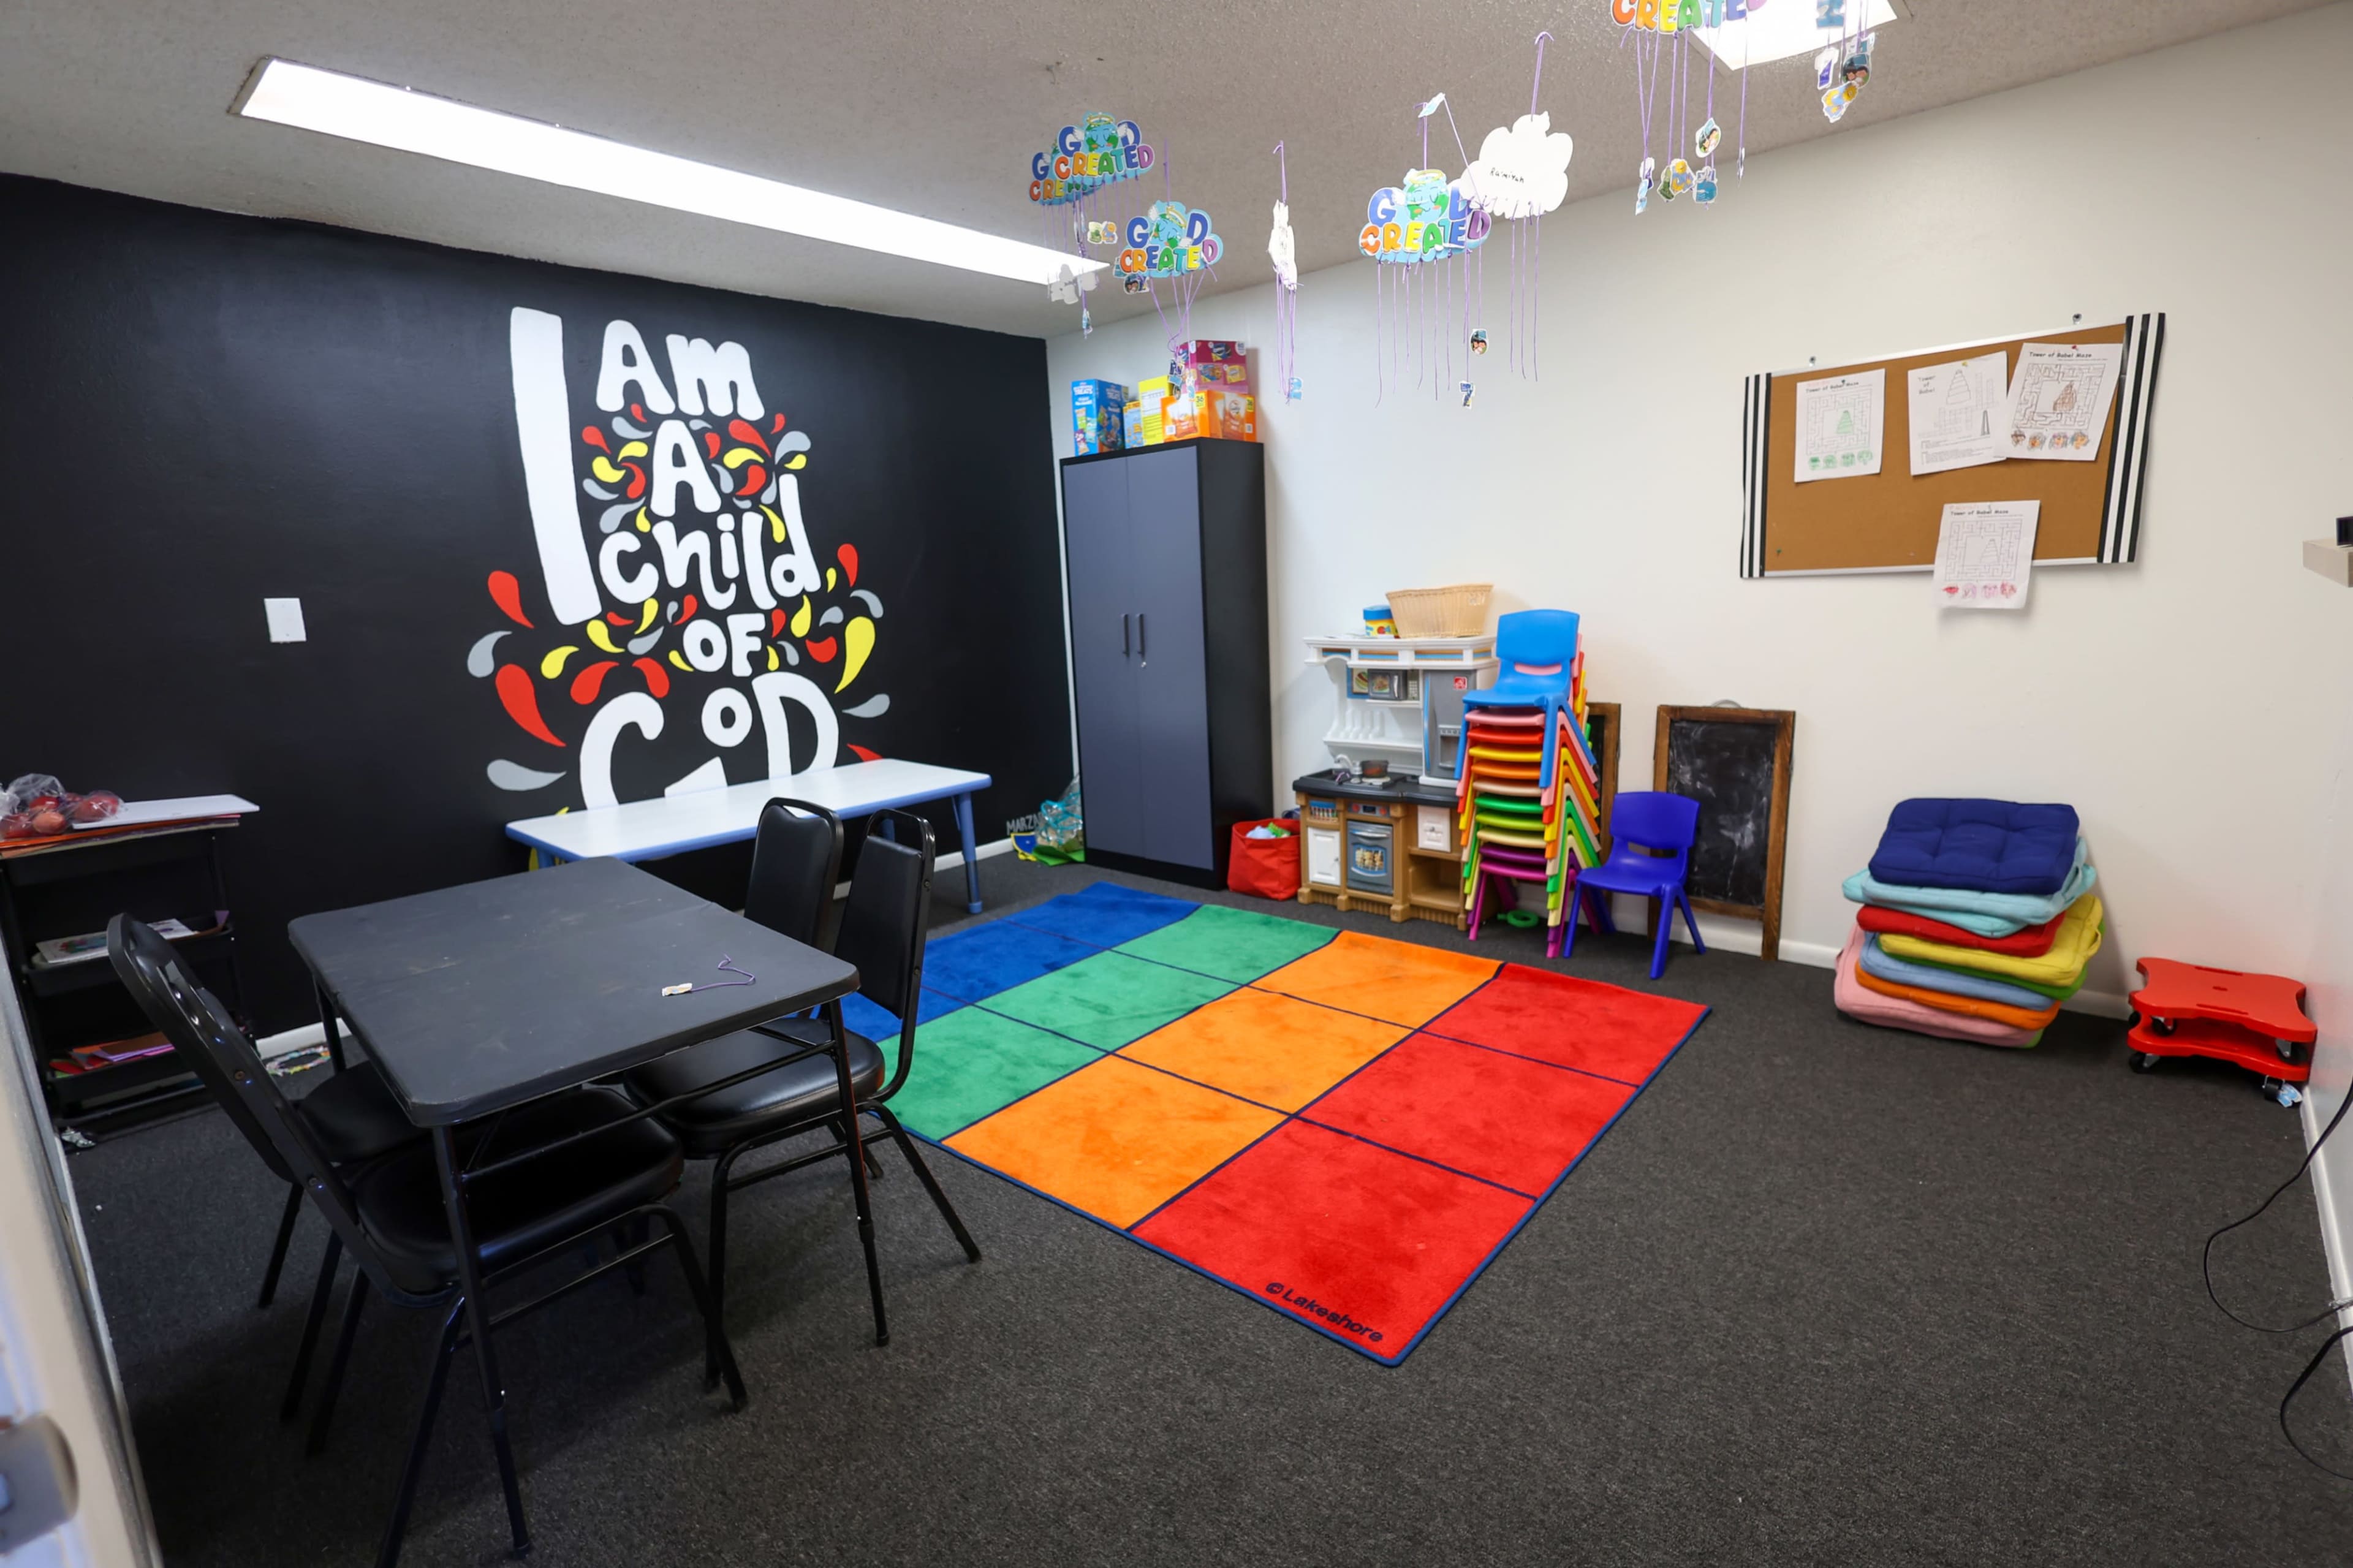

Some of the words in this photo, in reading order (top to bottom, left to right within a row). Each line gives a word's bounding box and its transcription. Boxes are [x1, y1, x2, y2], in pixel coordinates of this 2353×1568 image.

[1055, 145, 1154, 180] CREATED
[1120, 239, 1218, 273] CREATED
[1360, 209, 1490, 255] CREATED
[510, 306, 602, 625] I
[650, 419, 722, 517] A
[580, 671, 839, 811] GOD
